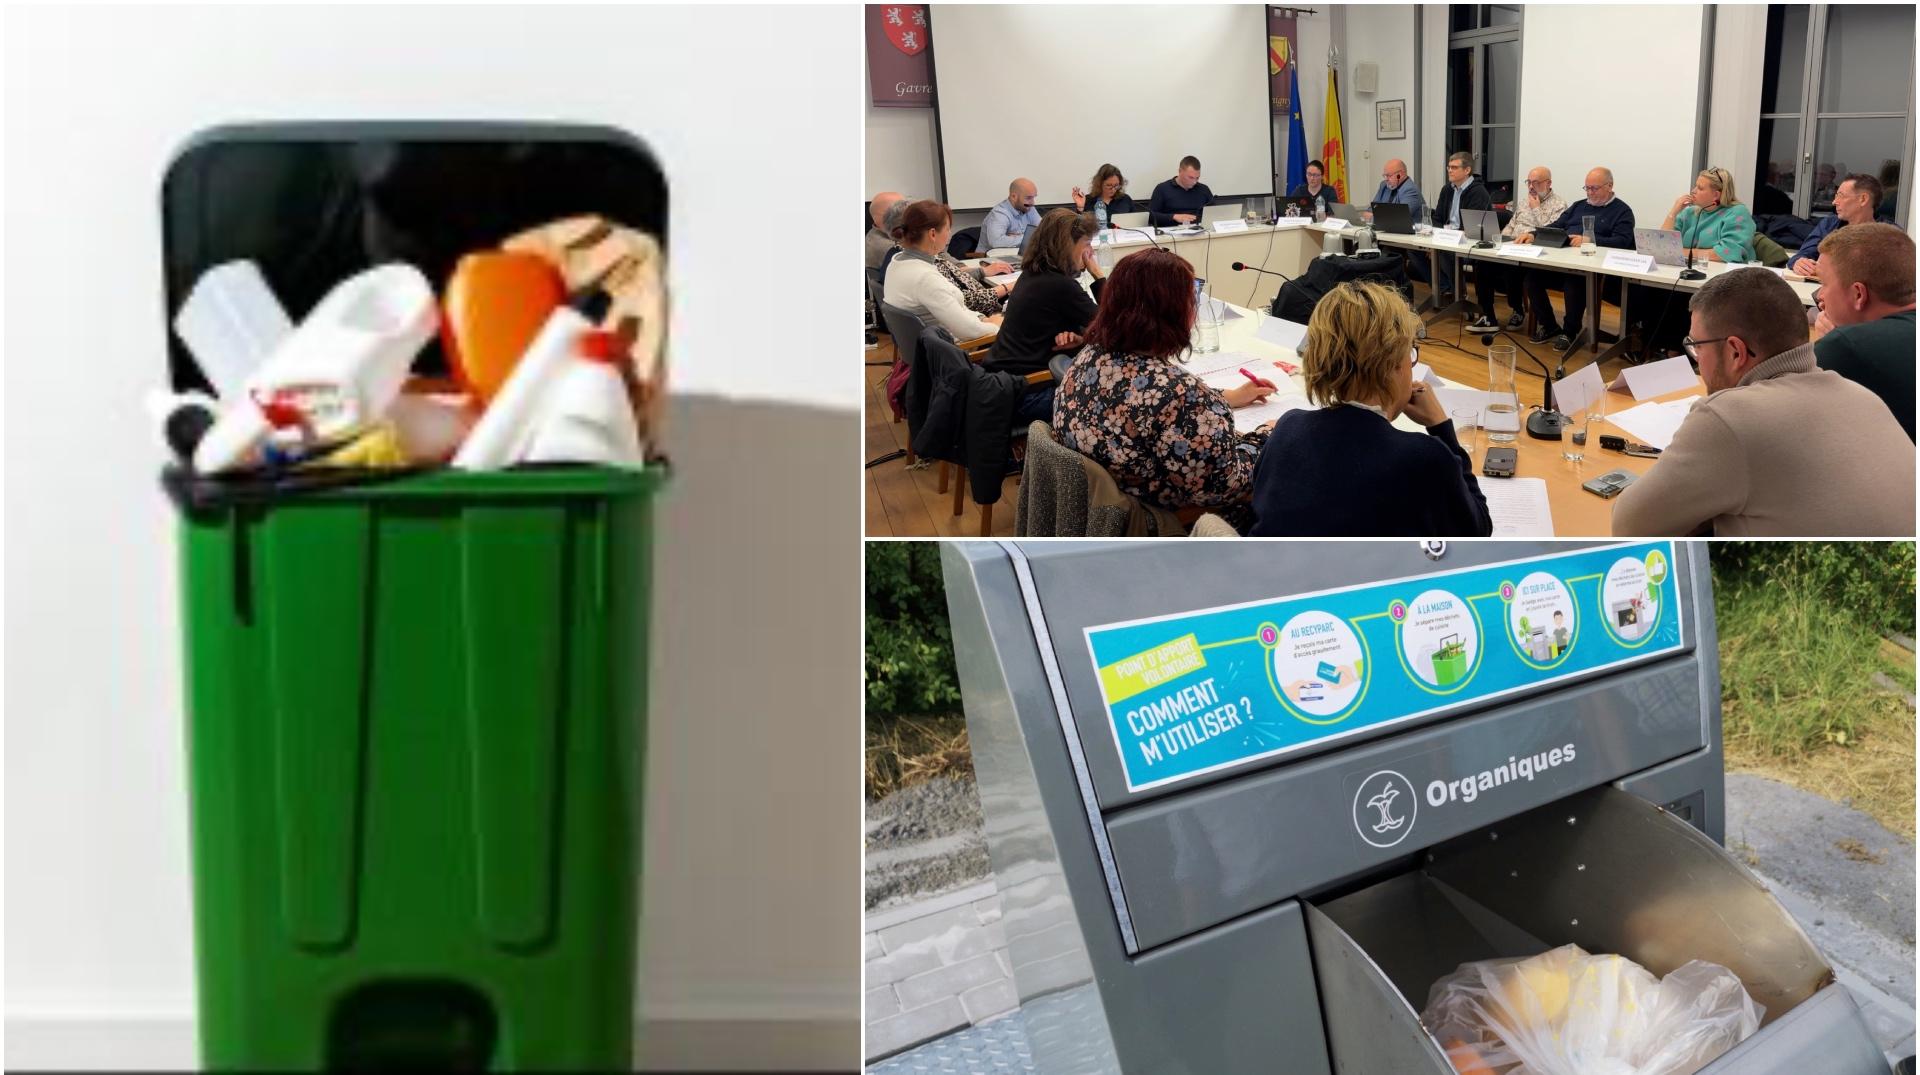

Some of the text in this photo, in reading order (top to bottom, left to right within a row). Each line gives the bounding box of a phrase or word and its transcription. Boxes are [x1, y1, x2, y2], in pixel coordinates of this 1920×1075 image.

[1430, 600, 1453, 612] MAISON
[1291, 622, 1335, 639] AU RECYPARC
[1115, 655, 1145, 680] POINT
[1142, 653, 1201, 685] VOLONTAIRE
[1126, 677, 1219, 736] COMMENT
[1139, 696, 1254, 766] M'UTILISER ?
[1426, 743, 1576, 807] Organiques
